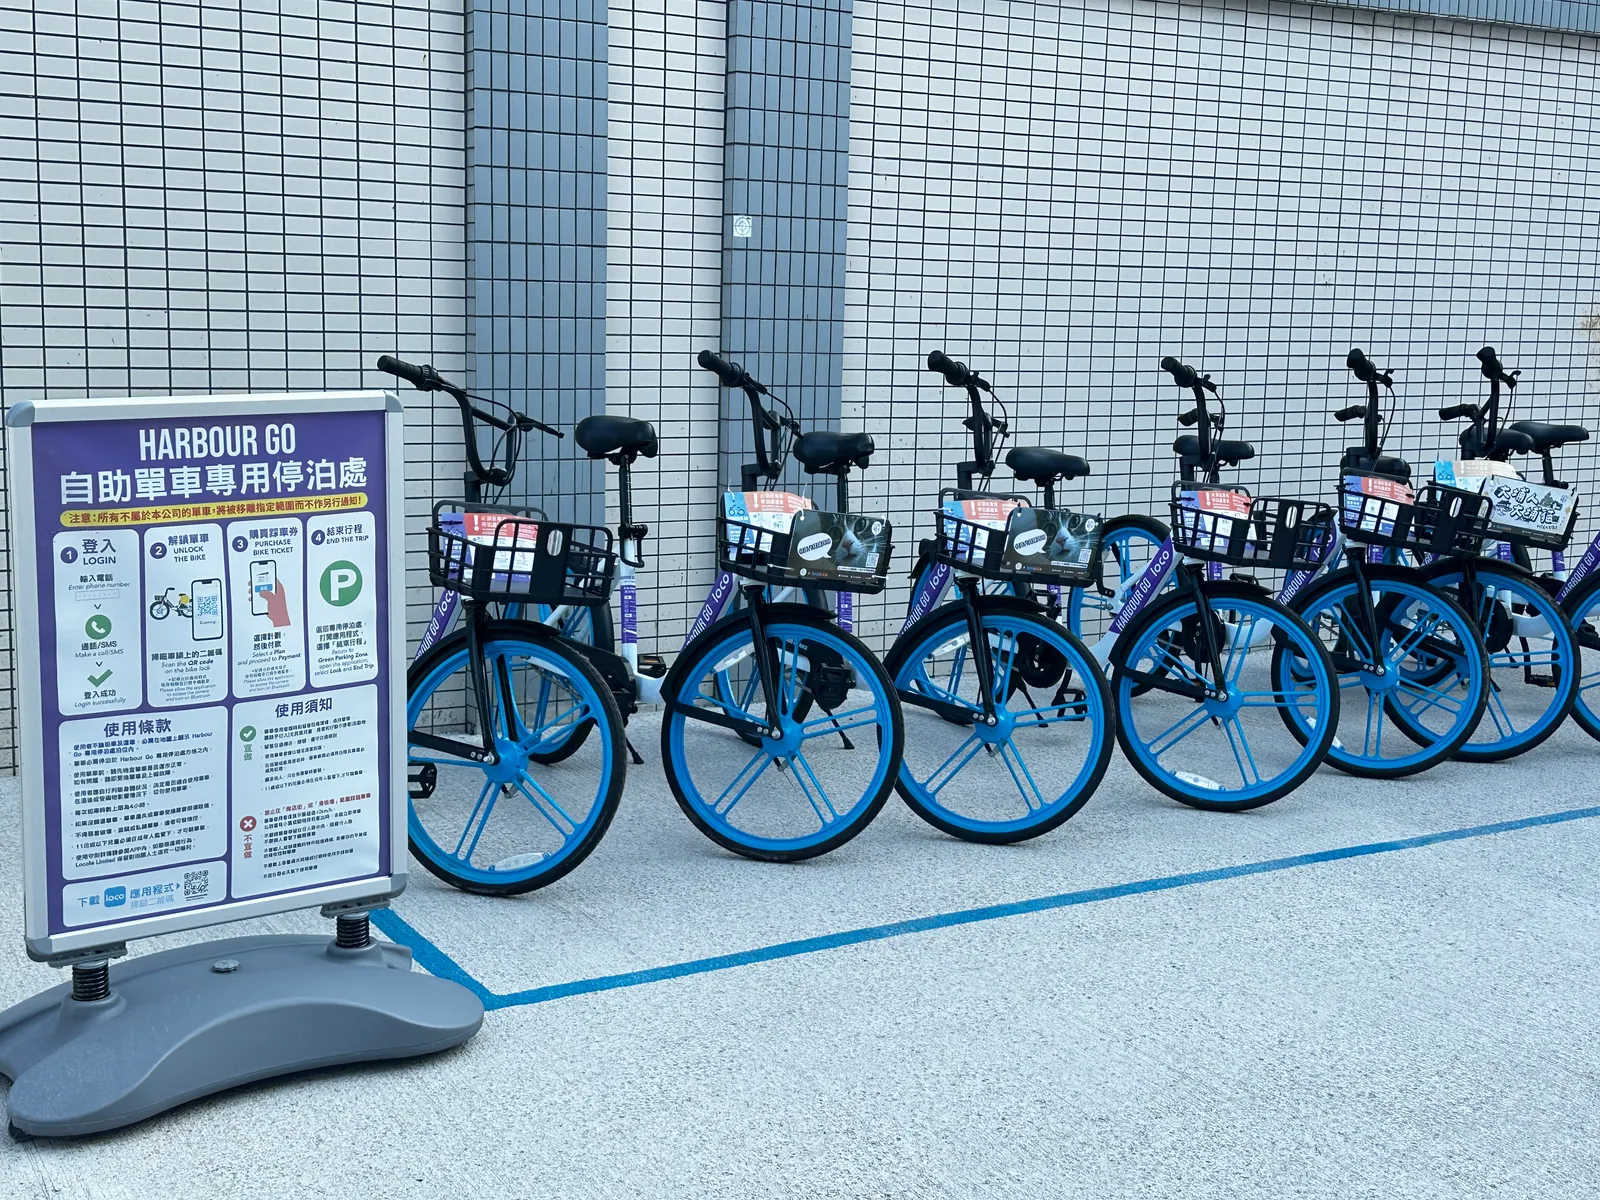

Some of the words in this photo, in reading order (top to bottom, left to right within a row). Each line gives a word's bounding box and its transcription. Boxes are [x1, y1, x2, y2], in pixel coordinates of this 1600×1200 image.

[139, 424, 257, 461] HARBOUR
[265, 423, 297, 455] GO
[60, 457, 367, 504] 自助單車專用停泊處
[1497, 485, 1539, 505] 大埔人
[326, 523, 363, 537] 結束行程
[168, 533, 209, 546] 解鎖單車
[255, 539, 291, 548] PURCHASE
[315, 533, 322, 542] 4
[326, 537, 340, 545] END
[82, 538, 117, 555] 登入
[155, 546, 163, 556] 2
[173, 546, 204, 554] UNLOCK
[237, 540, 244, 549] 3
[66, 550, 72, 560] 1
[253, 548, 269, 556] BIKE
[270, 547, 294, 555] TICKET
[83, 556, 116, 566] LOGIN
[1583, 552, 1595, 567] GO
[80, 574, 113, 583] 輸入電話
[330, 568, 357, 602] P
[86, 583, 105, 592] phone
[1115, 589, 1144, 632] HARBOUR
[1139, 577, 1151, 594] GO
[1150, 550, 1169, 577] loco
[702, 604, 713, 621] GO
[711, 574, 729, 603] loco
[919, 591, 931, 608] GO
[429, 617, 440, 636] GO
[81, 641, 117, 651] 通話/SMS
[84, 689, 117, 700] 登入成功
[74, 700, 92, 709] Login
[275, 697, 332, 718] 使用須知
[103, 718, 172, 738] 使用條款
[105, 893, 125, 902] loco
[130, 882, 174, 899] 應用程式
